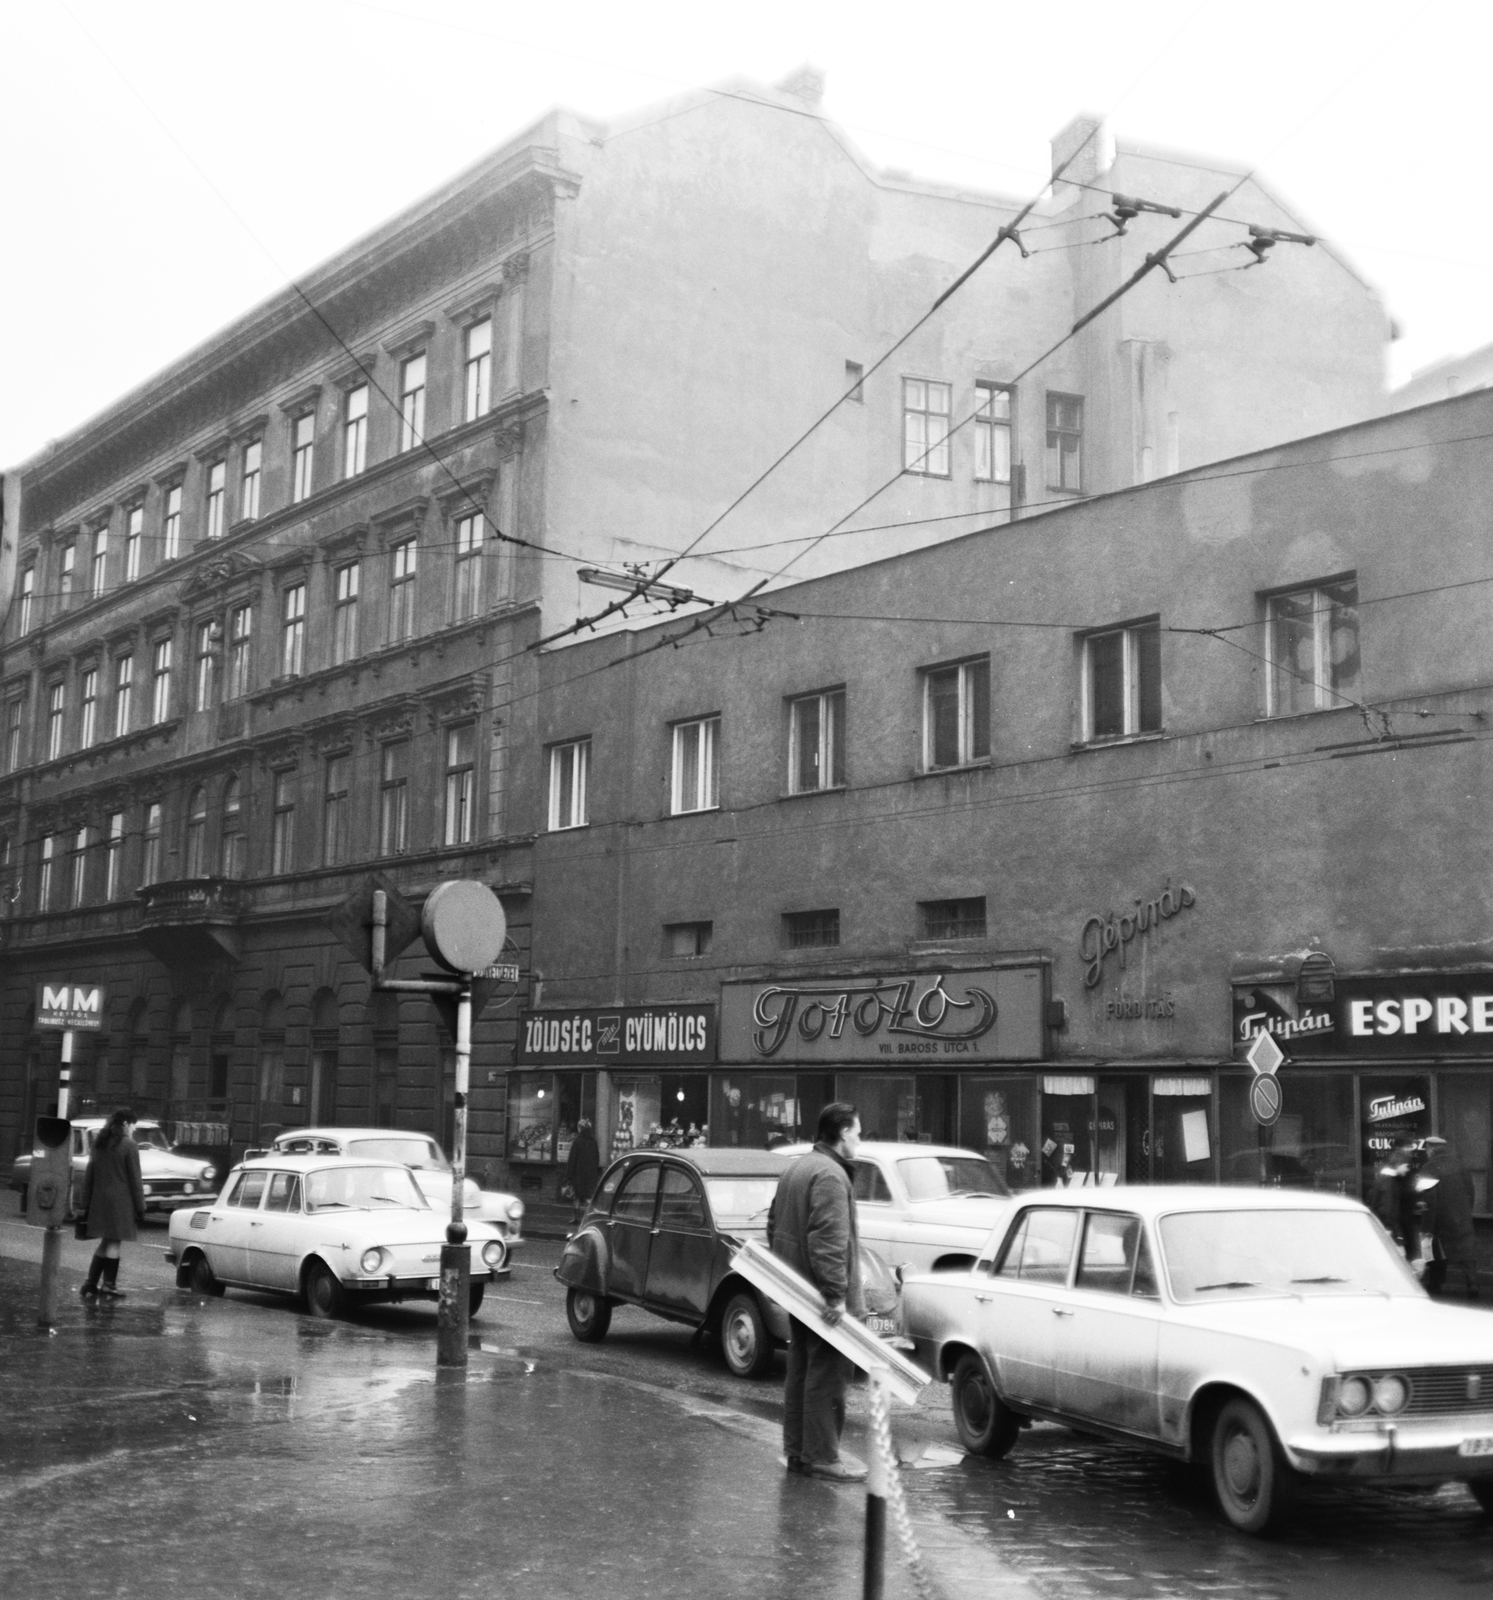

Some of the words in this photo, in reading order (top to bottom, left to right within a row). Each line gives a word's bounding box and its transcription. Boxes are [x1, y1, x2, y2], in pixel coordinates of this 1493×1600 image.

[42, 986, 99, 1012] MM
[525, 1016, 592, 1052] ZÖLDSÉG
[626, 1012, 706, 1051] GYÜMÖLCS
[898, 1042, 938, 1054] BAROSS
[944, 1041, 969, 1053] UTCA
